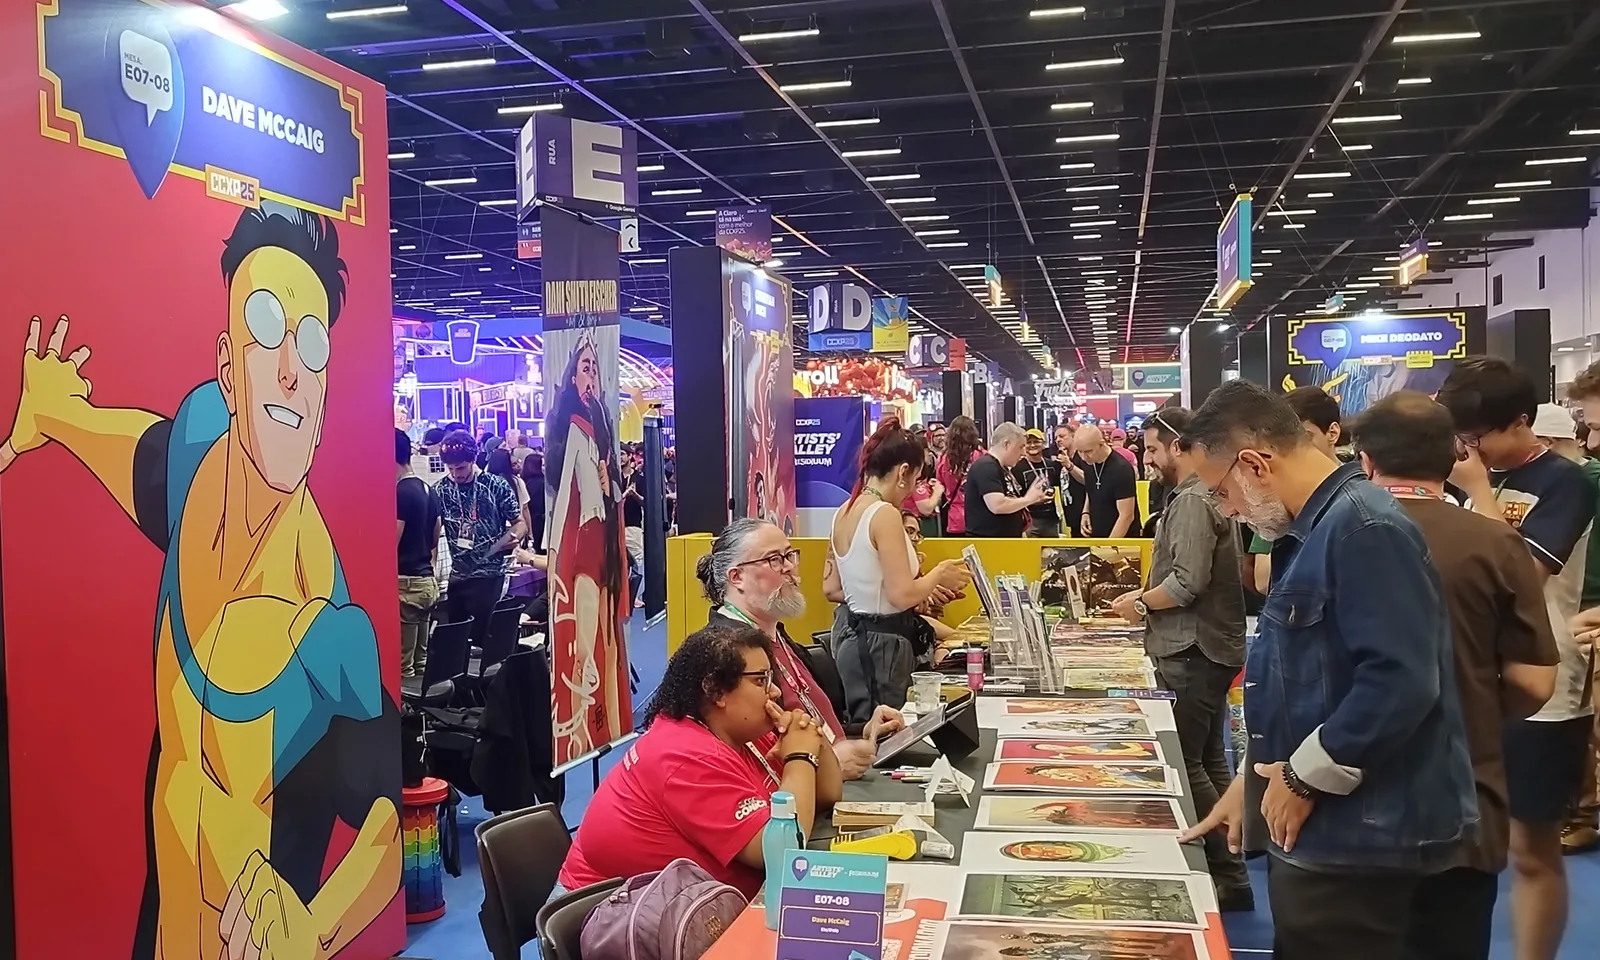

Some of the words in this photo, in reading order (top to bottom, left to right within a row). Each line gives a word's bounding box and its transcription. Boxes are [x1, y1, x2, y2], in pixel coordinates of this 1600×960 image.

[124, 63, 170, 93] E07-08
[202, 86, 255, 130] DAVE
[258, 107, 325, 154] MCCAIG
[548, 139, 556, 165] RUA
[571, 117, 625, 205] E
[210, 172, 255, 201] CCXP25
[545, 281, 565, 315] DANI
[589, 280, 617, 312] FISCHER
[813, 285, 829, 333] D
[842, 283, 872, 331] D
[909, 334, 921, 365] C
[930, 336, 947, 364] C
[1360, 333, 1388, 344] MIKE
[1389, 332, 1442, 343] DEODATO
[974, 363, 988, 384] B
[1002, 377, 1014, 395] A
[814, 894, 850, 906] E07-08
[811, 916, 828, 924] Dave
[828, 917, 850, 926] McCaig
